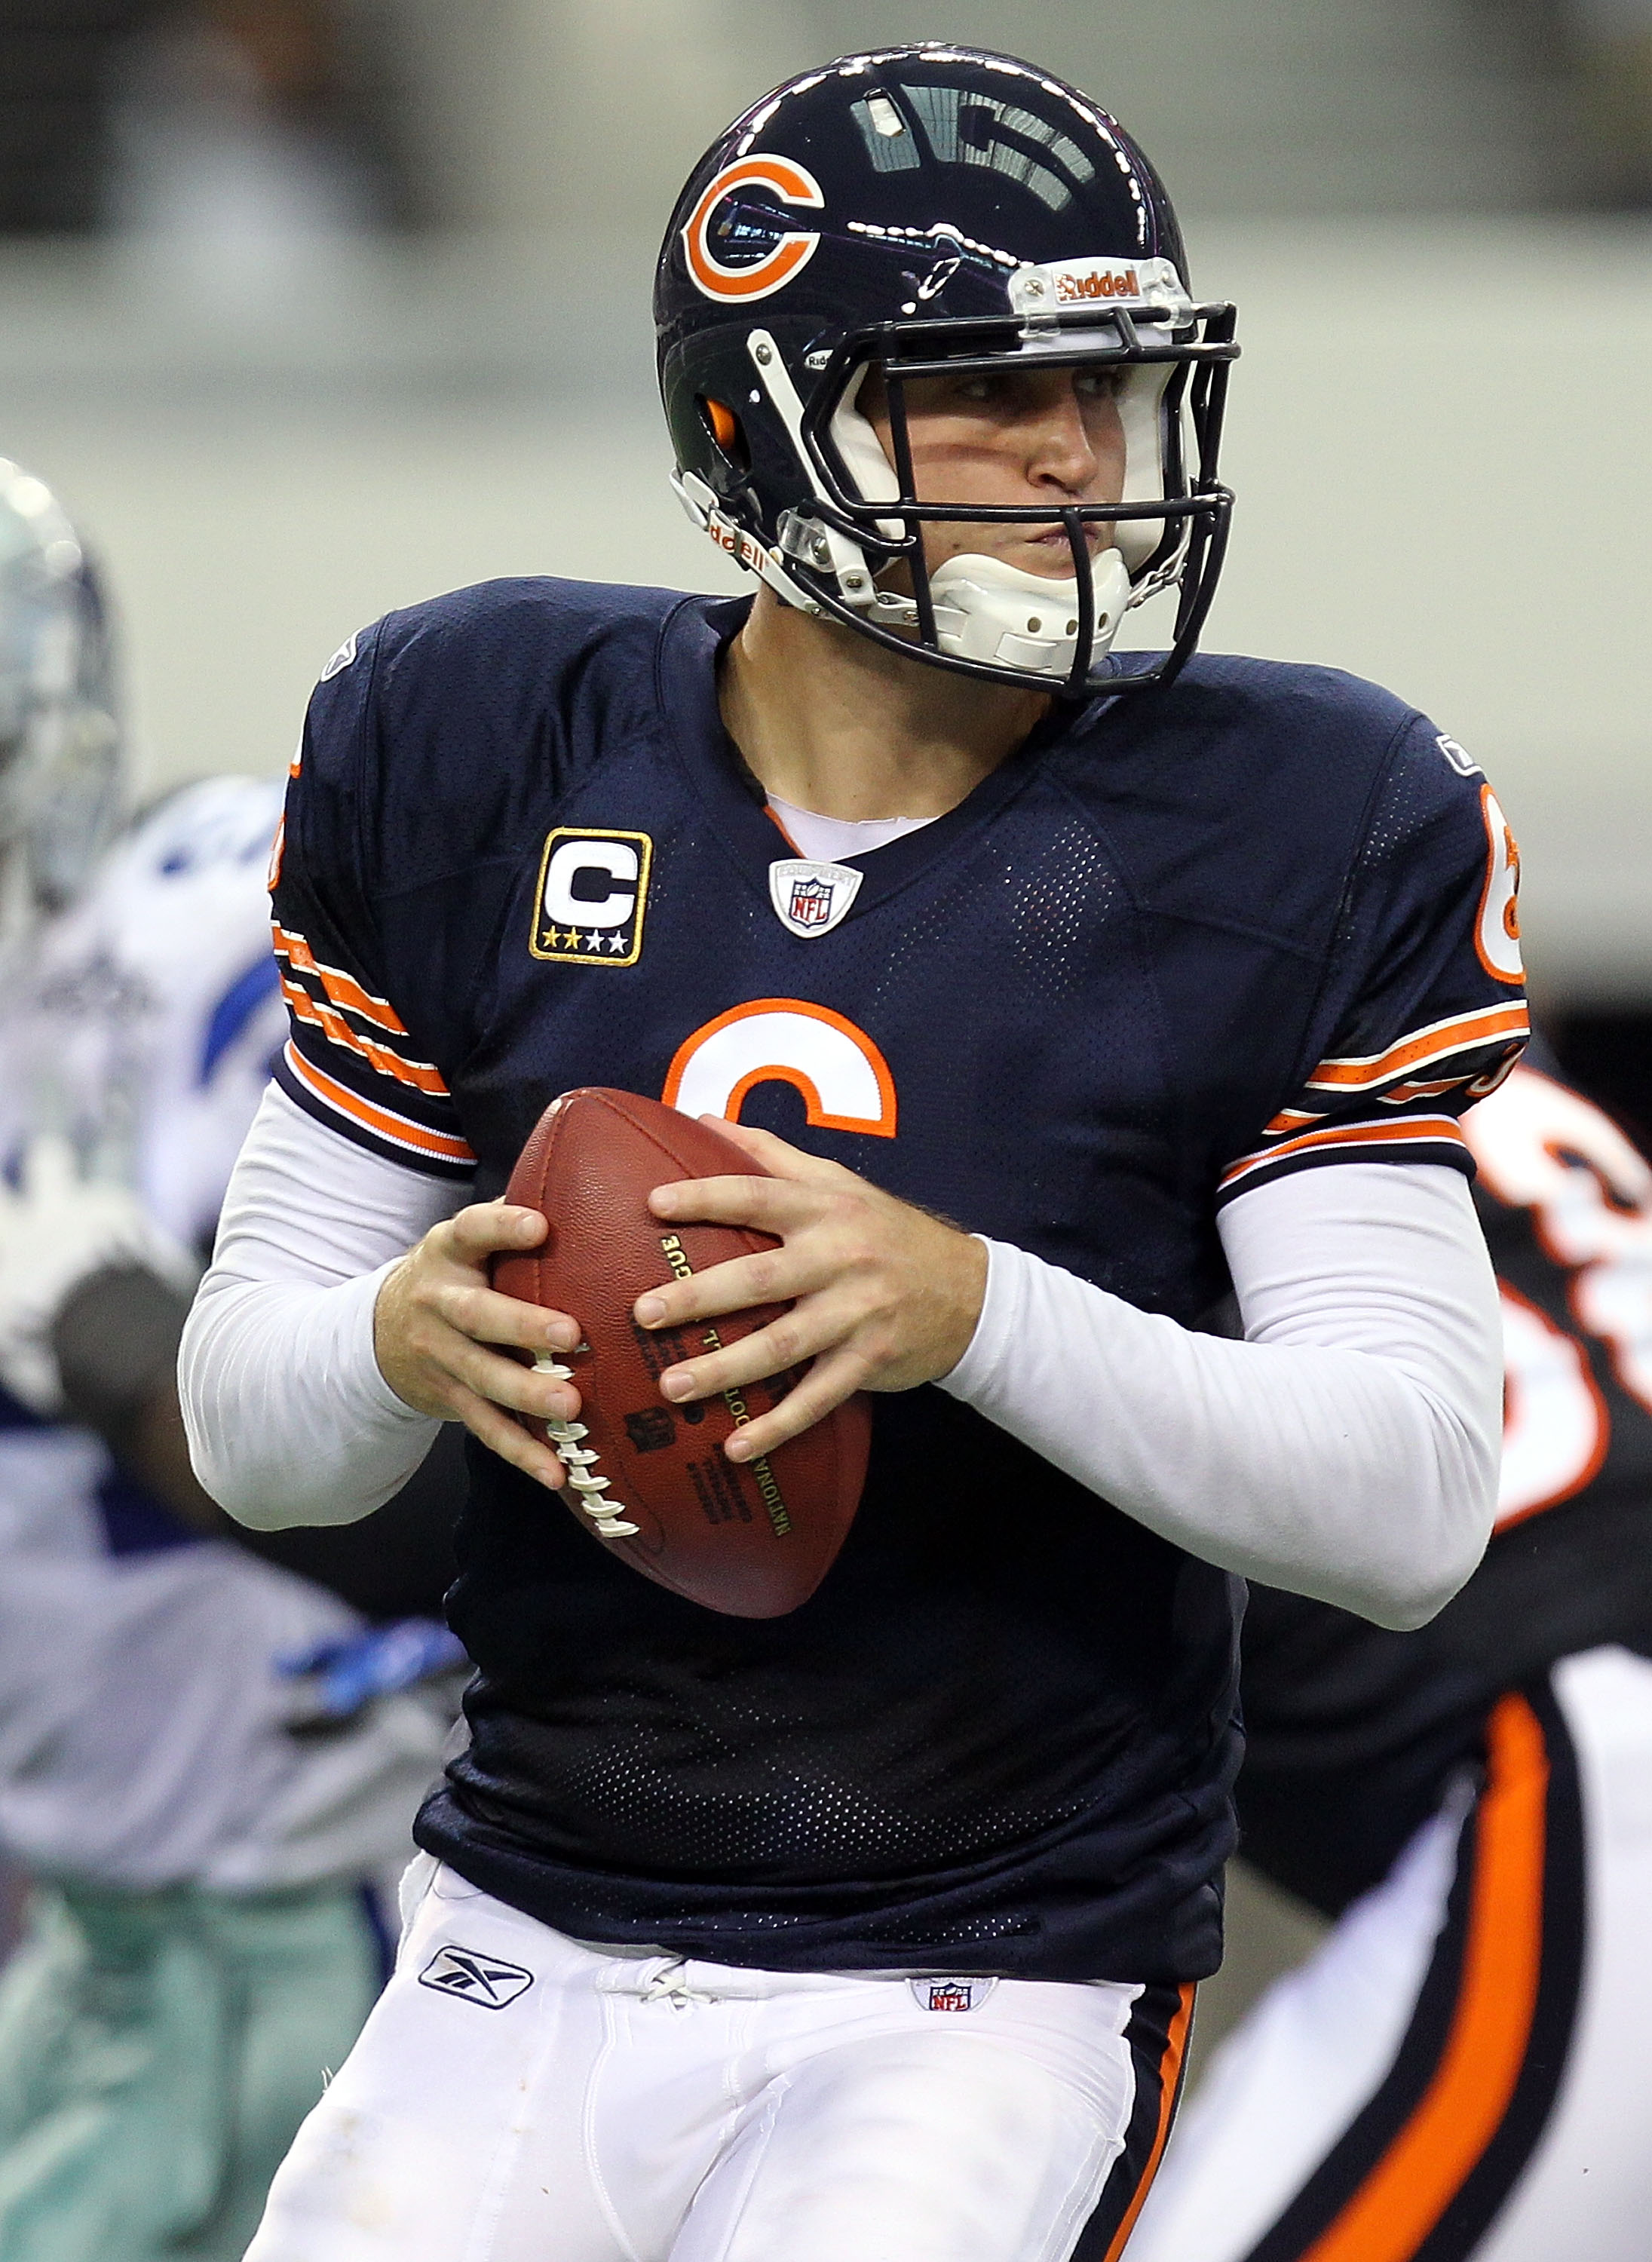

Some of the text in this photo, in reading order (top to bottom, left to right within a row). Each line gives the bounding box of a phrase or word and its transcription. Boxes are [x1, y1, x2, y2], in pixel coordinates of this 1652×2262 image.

[680, 153, 825, 303] C
[544, 841, 639, 929] C
[792, 897, 827, 922] NFL
[750, 1454, 792, 1537] NATIONA
[933, 1994, 968, 2011] NFL
